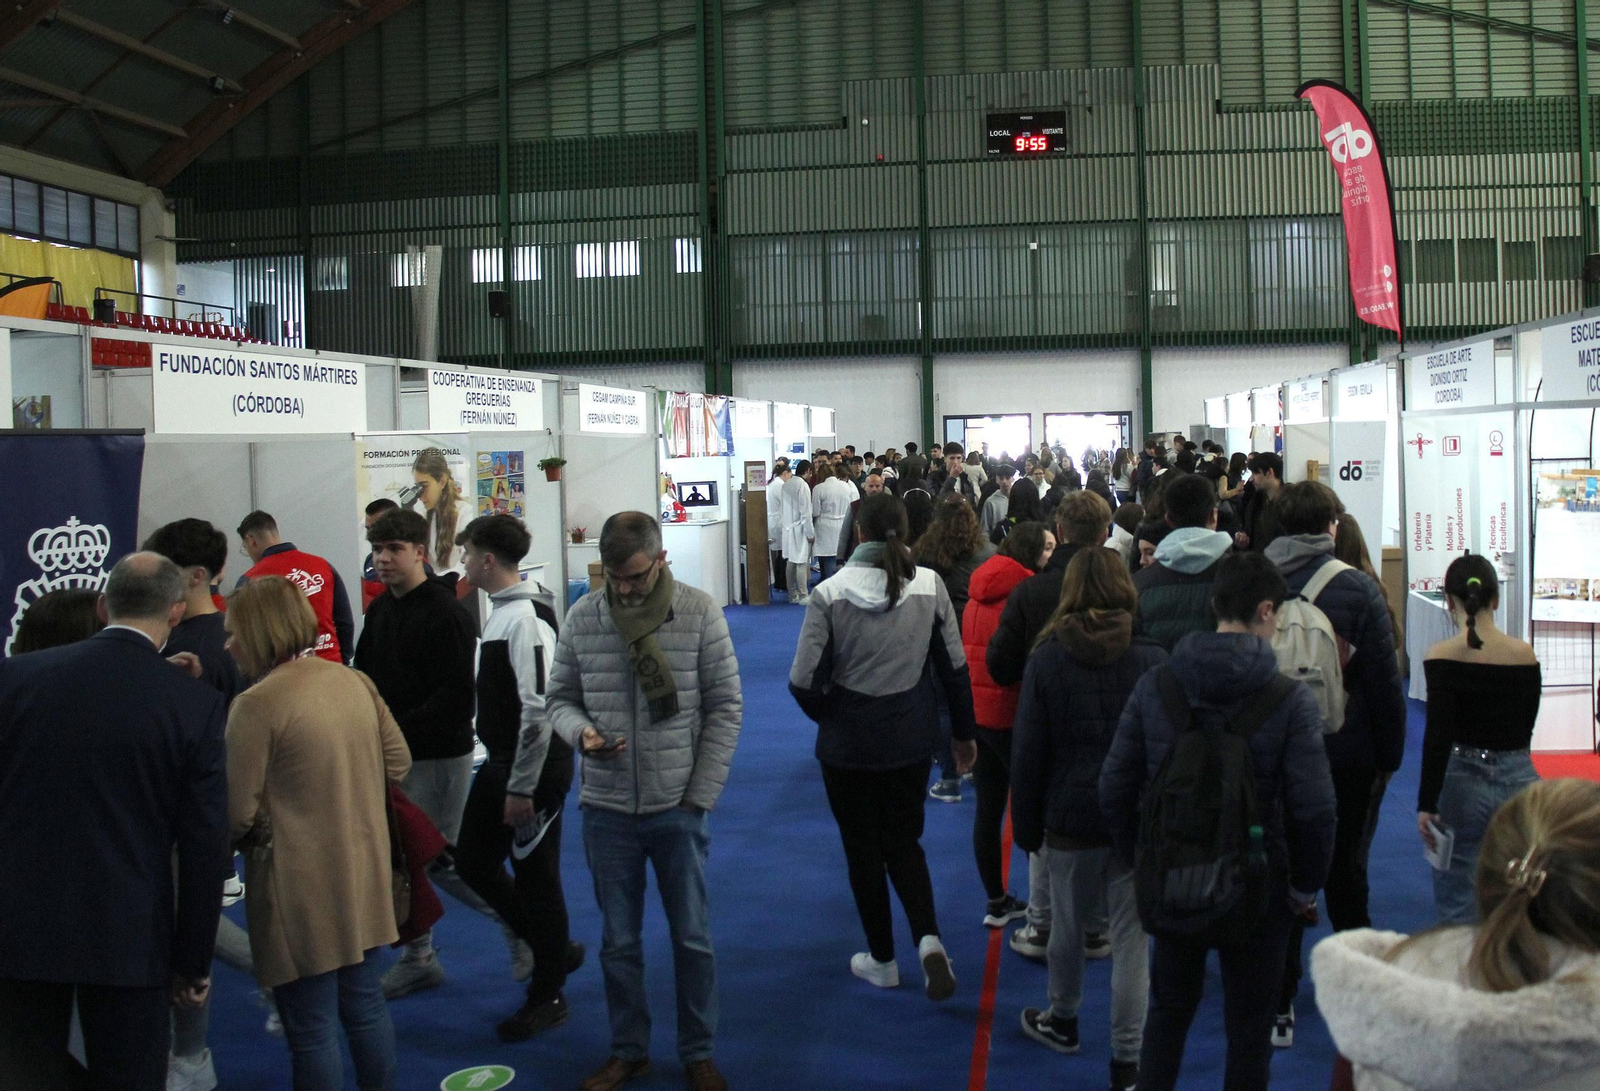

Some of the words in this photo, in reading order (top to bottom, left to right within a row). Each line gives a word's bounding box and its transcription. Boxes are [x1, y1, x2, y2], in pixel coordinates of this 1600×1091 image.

[1042, 127, 1064, 135] VISITANTE
[1016, 137, 1047, 152] 9:55
[1571, 320, 1600, 344] ESCUE
[1450, 350, 1457, 365] DE
[1457, 347, 1472, 363] ARTE
[160, 352, 246, 377] FUNDACIÓN
[250, 359, 300, 381] SANTOS
[303, 363, 358, 385] MÁRTIRES
[433, 371, 485, 390] COOPERATIVA
[487, 377, 496, 391] DE
[232, 391, 305, 418] (CÓRDOBA)
[465, 391, 511, 408] GREGUERÍAS
[460, 409, 492, 427] (FERNÁN
[363, 448, 410, 459] FORMACIÓN
[411, 448, 461, 458] PROFESIONAL
[1414, 512, 1422, 551] Orfebrería
[1424, 514, 1432, 544] Platería
[1456, 488, 1465, 551] Reproducciones
[1499, 502, 1507, 550] Escultóricas
[1488, 515, 1496, 550] Técnicas
